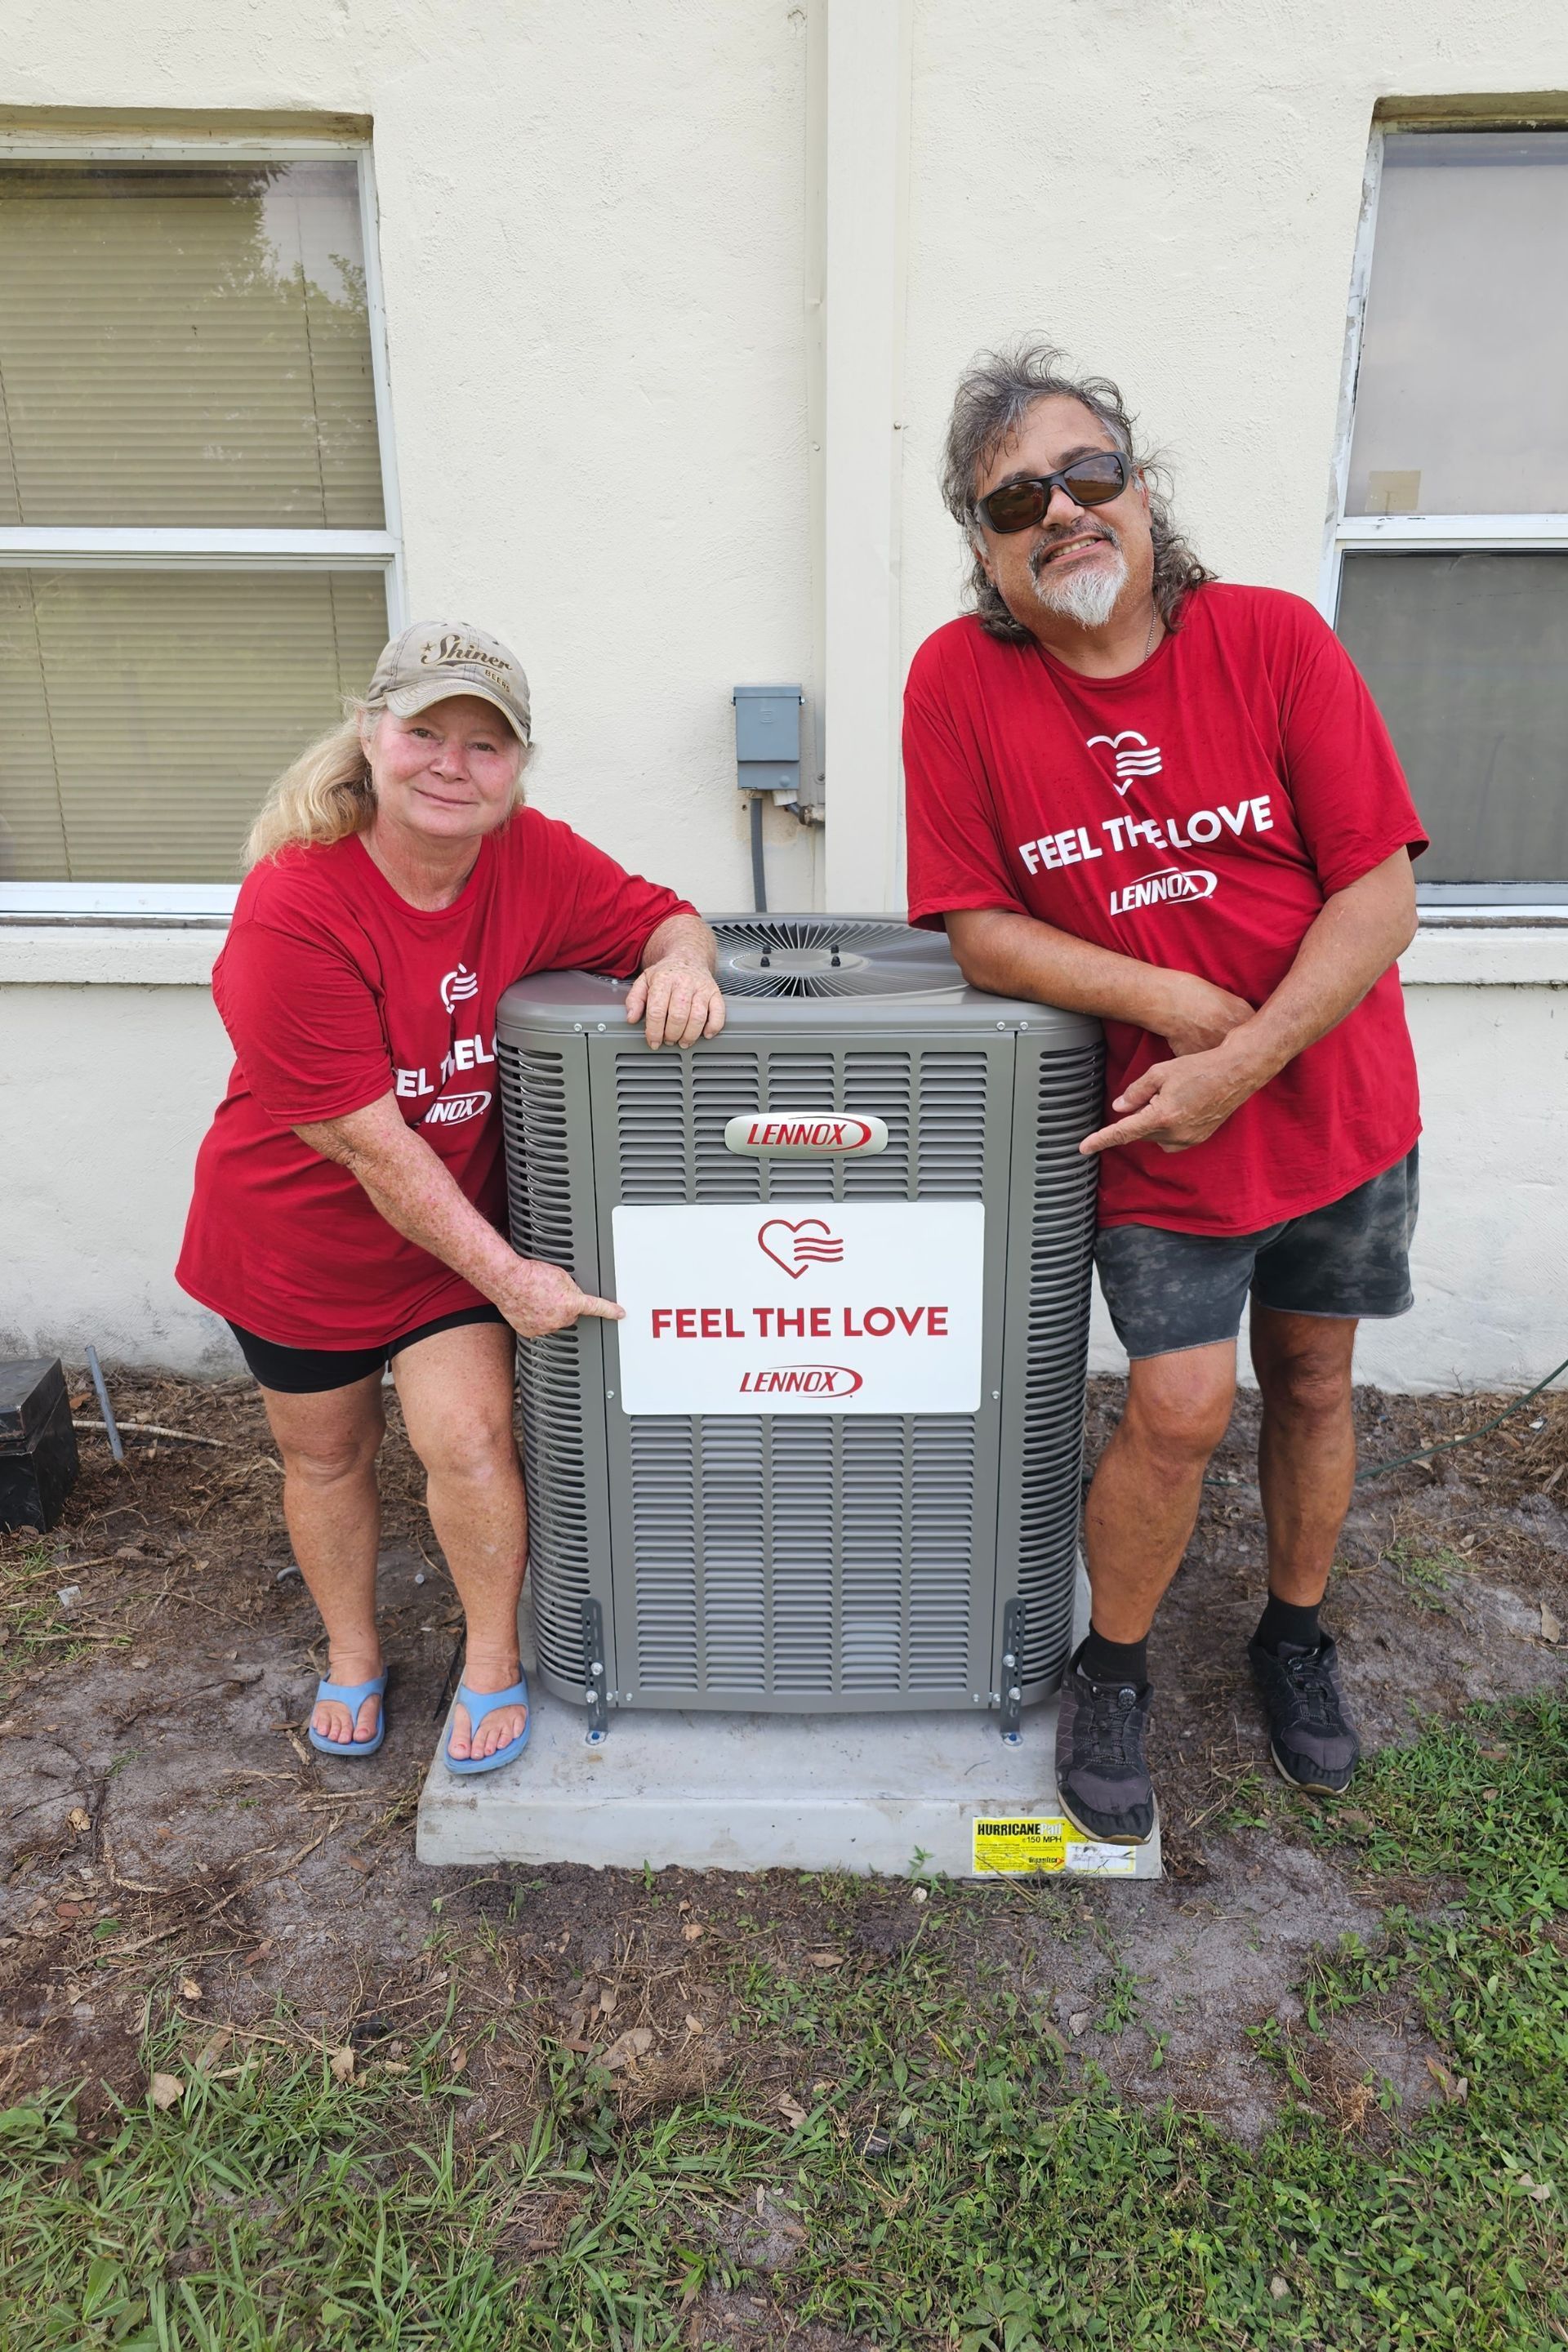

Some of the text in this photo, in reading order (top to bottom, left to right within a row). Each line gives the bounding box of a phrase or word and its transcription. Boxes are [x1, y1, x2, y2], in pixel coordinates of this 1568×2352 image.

[421, 635, 513, 671] Shiner
[485, 669, 510, 693] BEERS
[1018, 795, 1274, 875] FEEL THE LOVE
[1110, 871, 1199, 916] LENNOX
[392, 1067, 434, 1098] EL
[746, 1123, 848, 1146] LENNOX
[652, 1306, 949, 1339] FEEL THE LOVE
[739, 1371, 840, 1393] LENNOX
